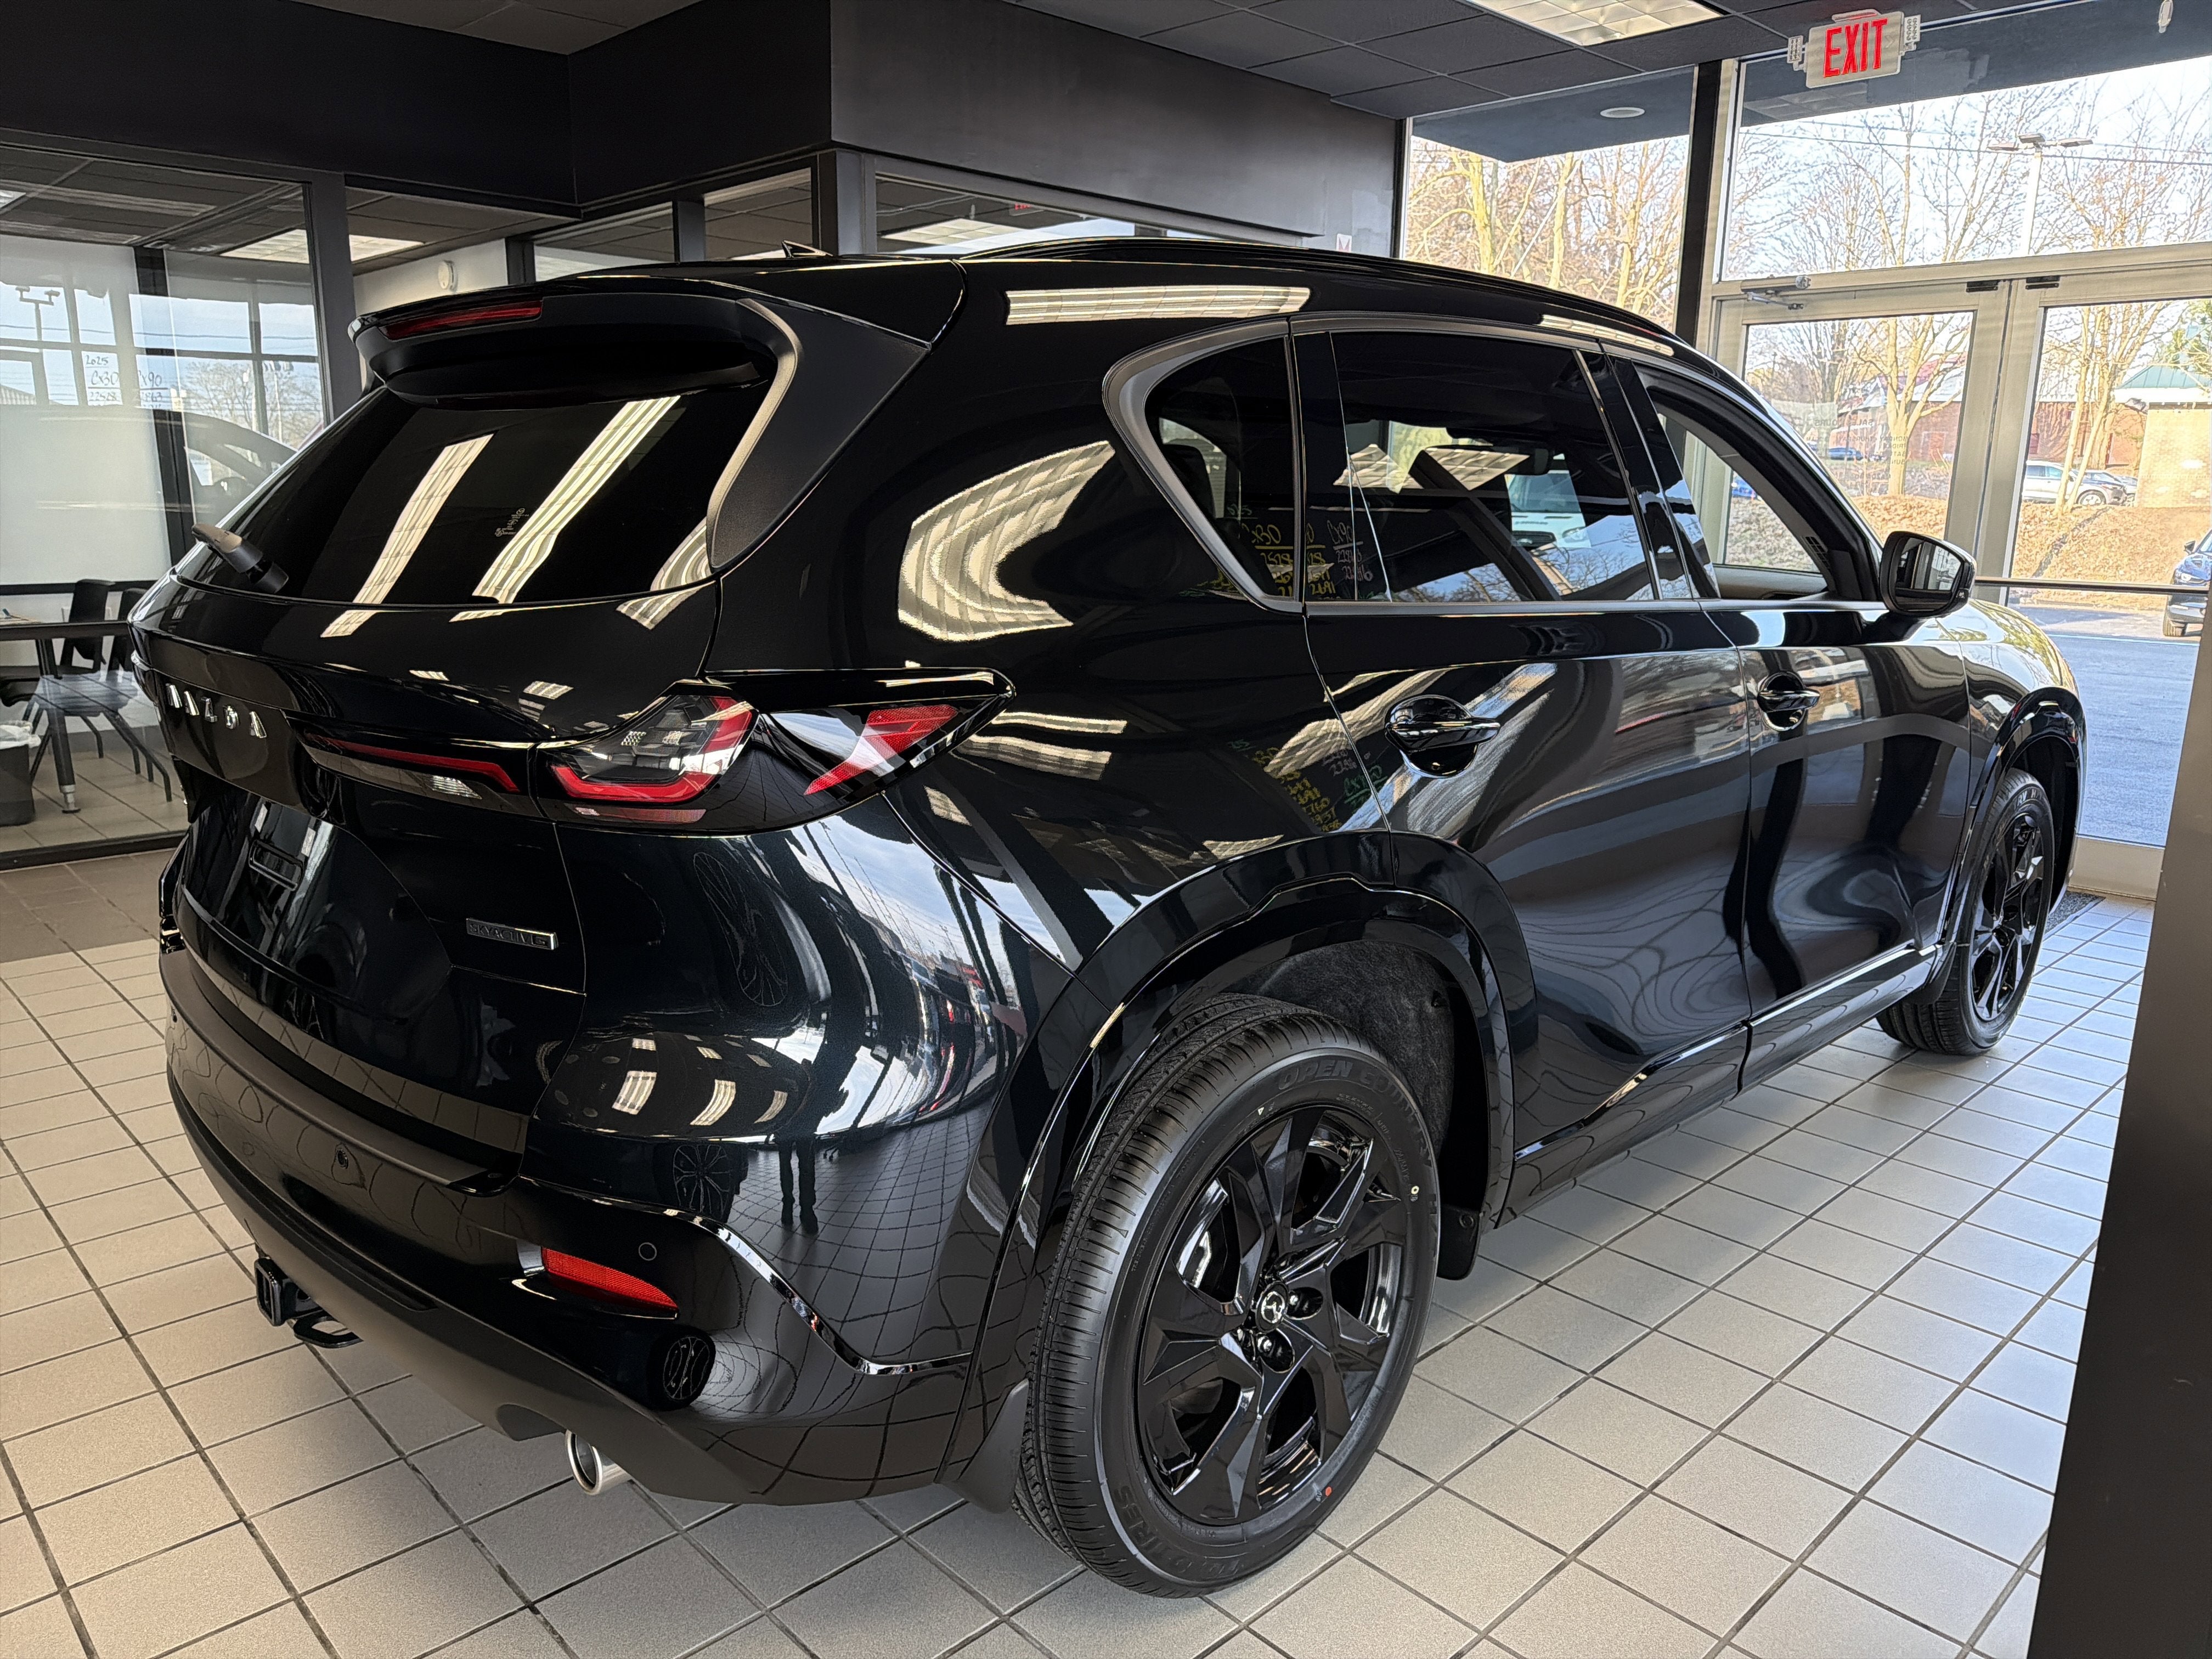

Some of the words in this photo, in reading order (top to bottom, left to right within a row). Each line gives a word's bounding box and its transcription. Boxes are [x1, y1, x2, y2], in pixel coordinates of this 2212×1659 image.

[1823, 17, 1888, 78] EXIT
[86, 354, 109, 365] 2025
[1278, 1059, 1353, 1090] OPEN
